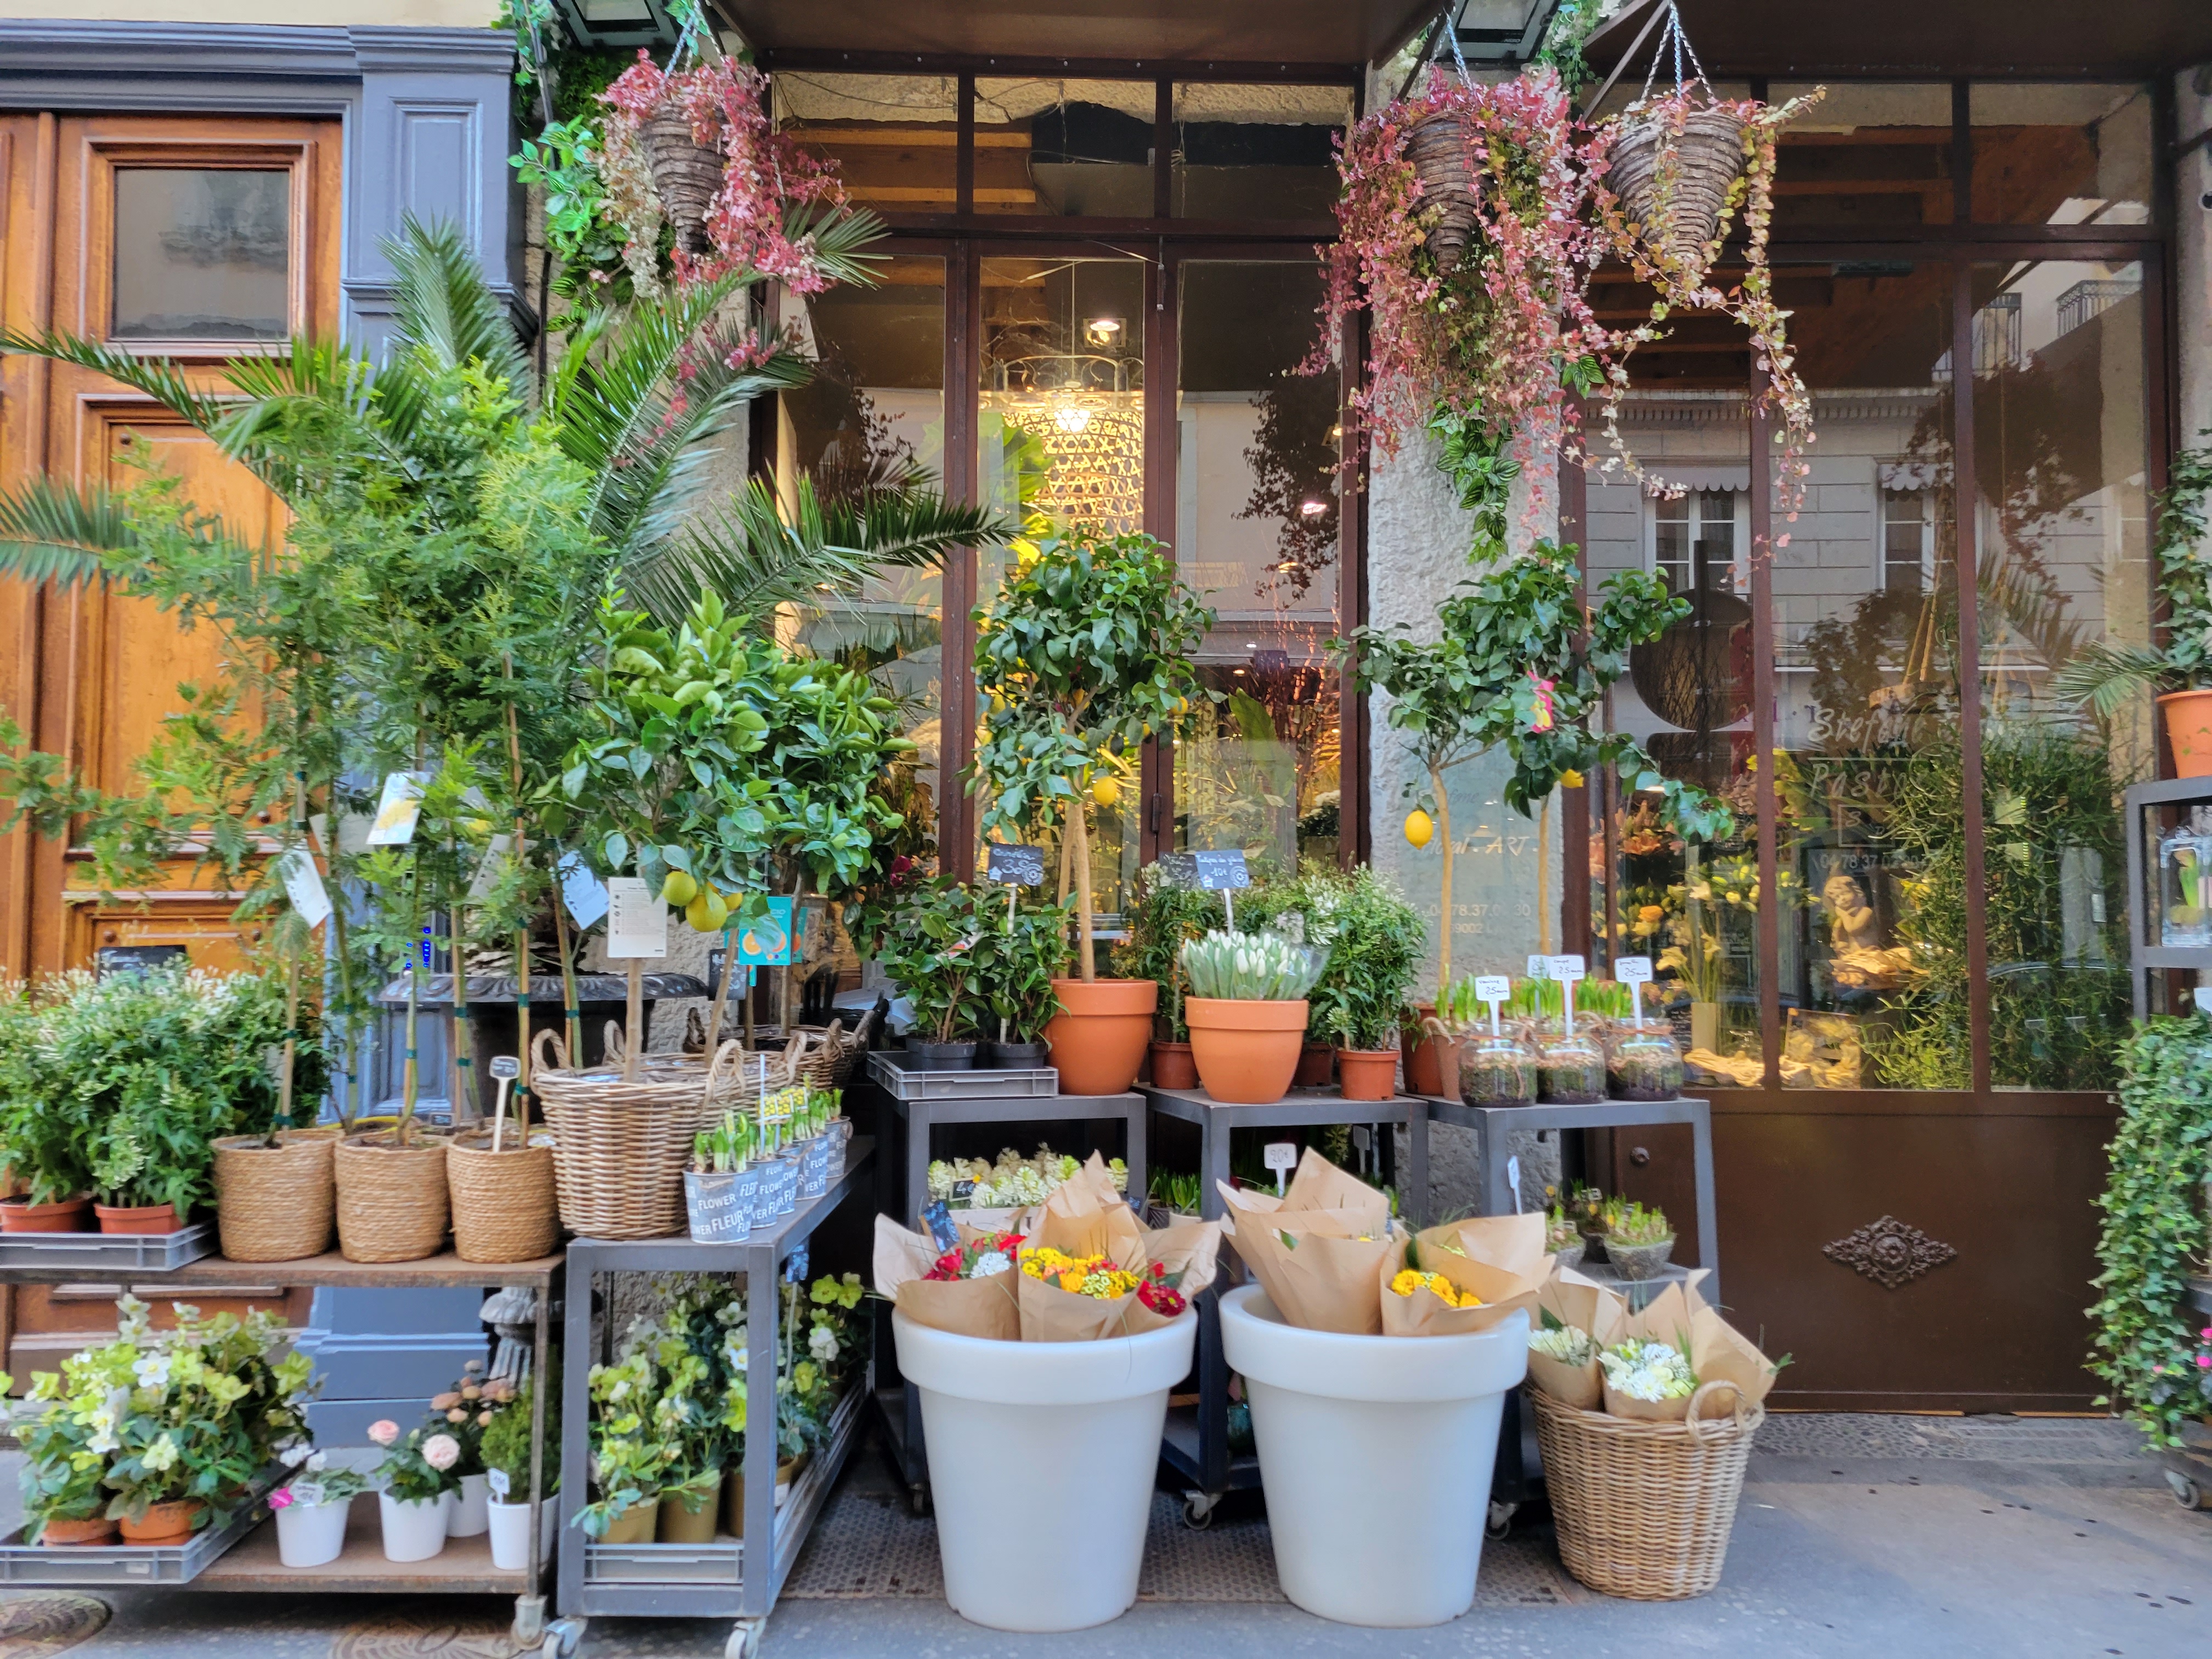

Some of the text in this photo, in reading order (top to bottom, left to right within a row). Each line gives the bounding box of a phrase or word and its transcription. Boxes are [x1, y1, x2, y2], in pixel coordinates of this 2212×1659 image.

[1841, 854, 1858, 869] 78
[1862, 855, 1877, 869] 37
[697, 1193, 737, 1211] FLOWER
[711, 1210, 744, 1232] FLEUR
